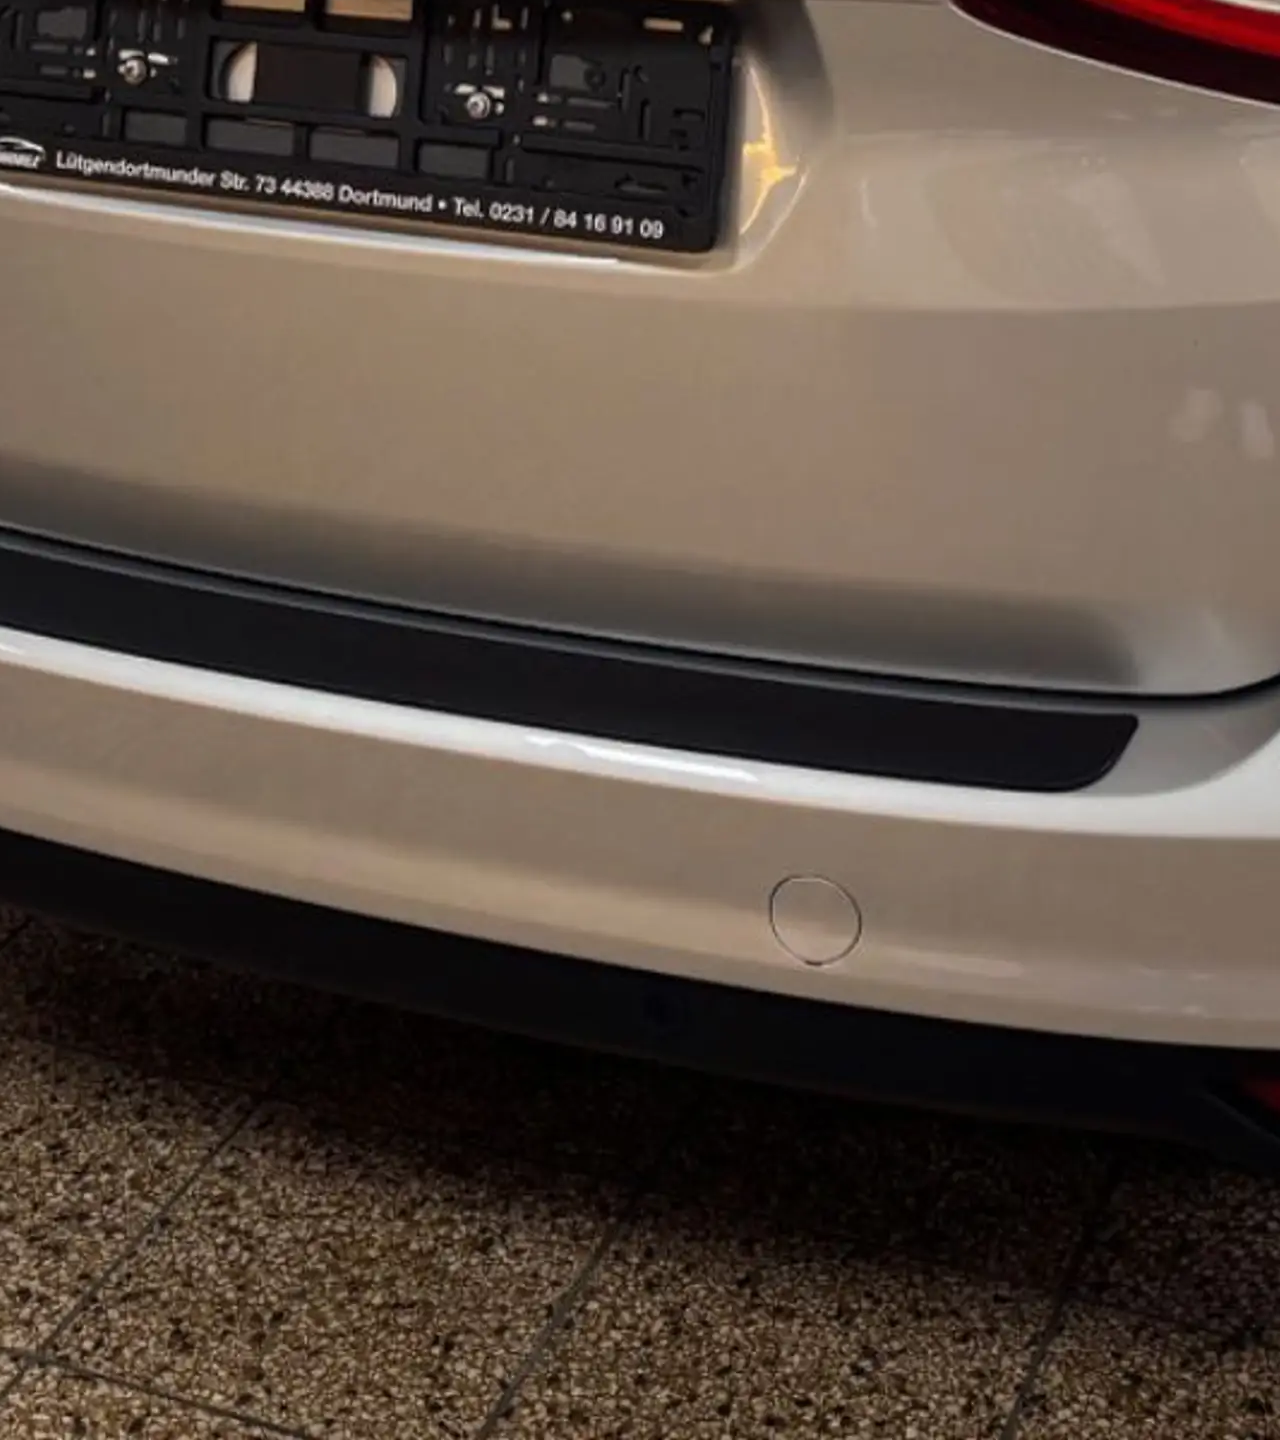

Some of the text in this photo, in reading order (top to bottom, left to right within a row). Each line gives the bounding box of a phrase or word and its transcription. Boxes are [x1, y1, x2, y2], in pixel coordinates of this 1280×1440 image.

[56, 150, 216, 187] Lütgendortmunder
[220, 170, 250, 192] Str.
[256, 175, 276, 194] 73
[281, 178, 334, 201] 44388
[338, 185, 433, 212] Dortmund
[453, 196, 485, 219] Tel.
[489, 201, 534, 224] 0231
[554, 210, 578, 229] 84
[584, 213, 606, 232] 16
[611, 215, 633, 235] 91
[640, 219, 664, 240] 09
